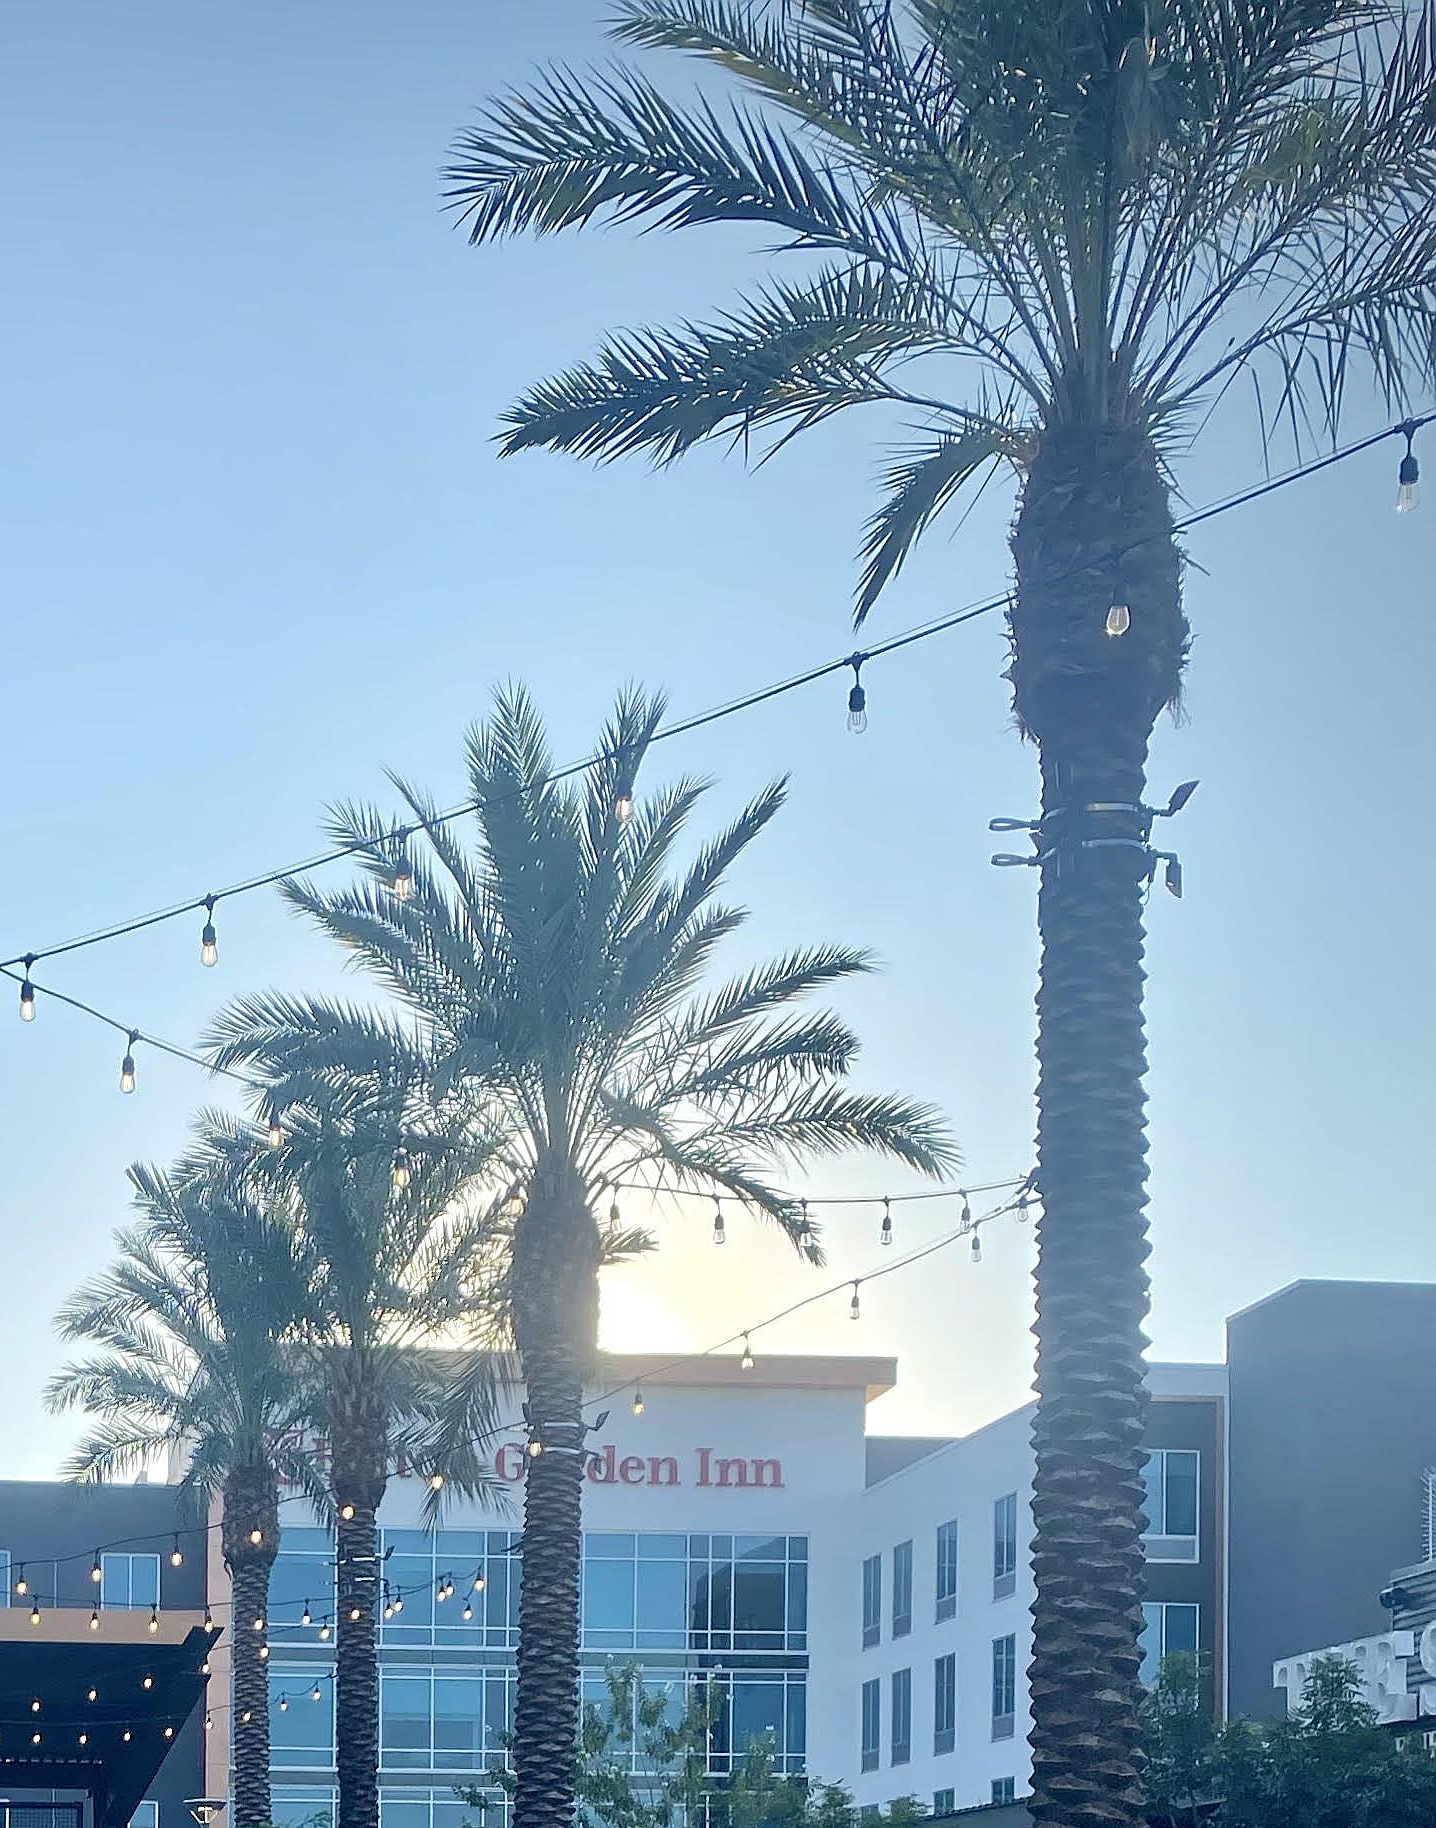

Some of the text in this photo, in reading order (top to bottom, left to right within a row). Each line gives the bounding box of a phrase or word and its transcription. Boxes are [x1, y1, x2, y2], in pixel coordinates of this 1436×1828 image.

[495, 1443, 681, 1486] Gden
[695, 1447, 785, 1488] Inn
[1272, 1630, 1418, 1727] TE
